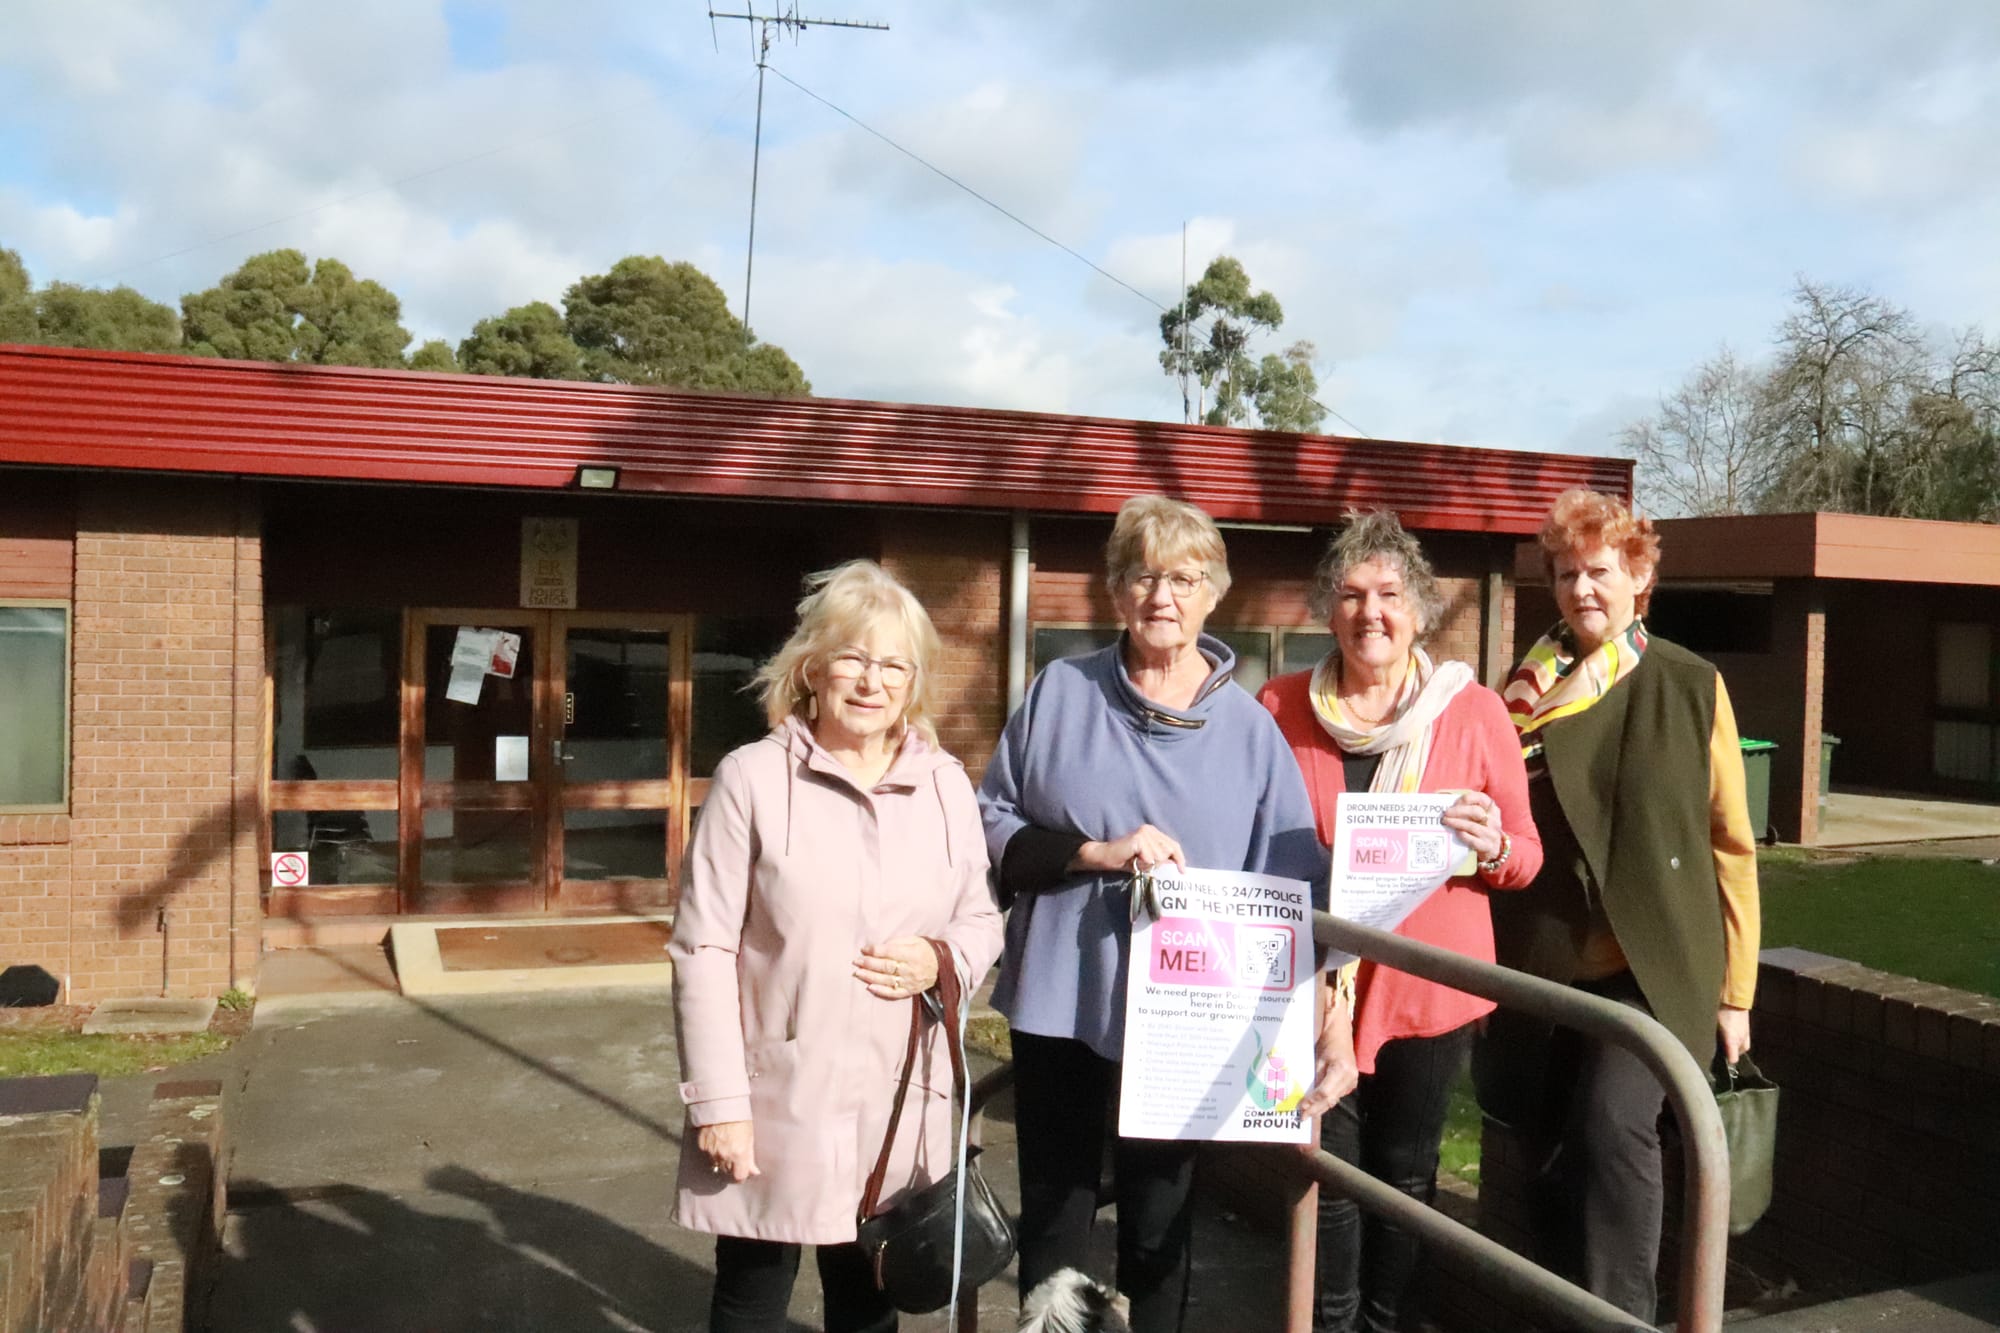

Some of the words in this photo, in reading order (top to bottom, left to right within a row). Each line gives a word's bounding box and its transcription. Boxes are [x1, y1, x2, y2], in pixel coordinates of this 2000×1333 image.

[530, 588, 568, 597] POLICE
[1346, 803, 1378, 812] DROUIN
[1380, 804, 1406, 812] NEEDS
[1407, 804, 1428, 813] 24/7
[1346, 815, 1374, 824] SIGN
[1377, 815, 1400, 824] THE
[1402, 816, 1440, 825] PETITI
[1356, 836, 1388, 848] SCAN
[1355, 848, 1387, 865] ME!
[1157, 879, 1192, 892] ROUIN
[1195, 883, 1228, 897] NEES
[1231, 886, 1262, 899] 24/7
[1264, 888, 1303, 905] POLICE
[1161, 896, 1188, 910] GN
[1195, 898, 1222, 914] HE
[1160, 930, 1209, 947] SCAN
[1160, 948, 1207, 973] ME!
[1145, 986, 1161, 995] We
[1164, 988, 1188, 997] need
[1189, 990, 1222, 1000] proper
[1190, 997, 1213, 1009] here
[1215, 1000, 1224, 1009] in
[1138, 1006, 1148, 1015] to
[1150, 1007, 1188, 1018] support
[1190, 1010, 1207, 1018] our
[1209, 1011, 1251, 1022] growing
[1243, 1118, 1301, 1130] DROUIN
